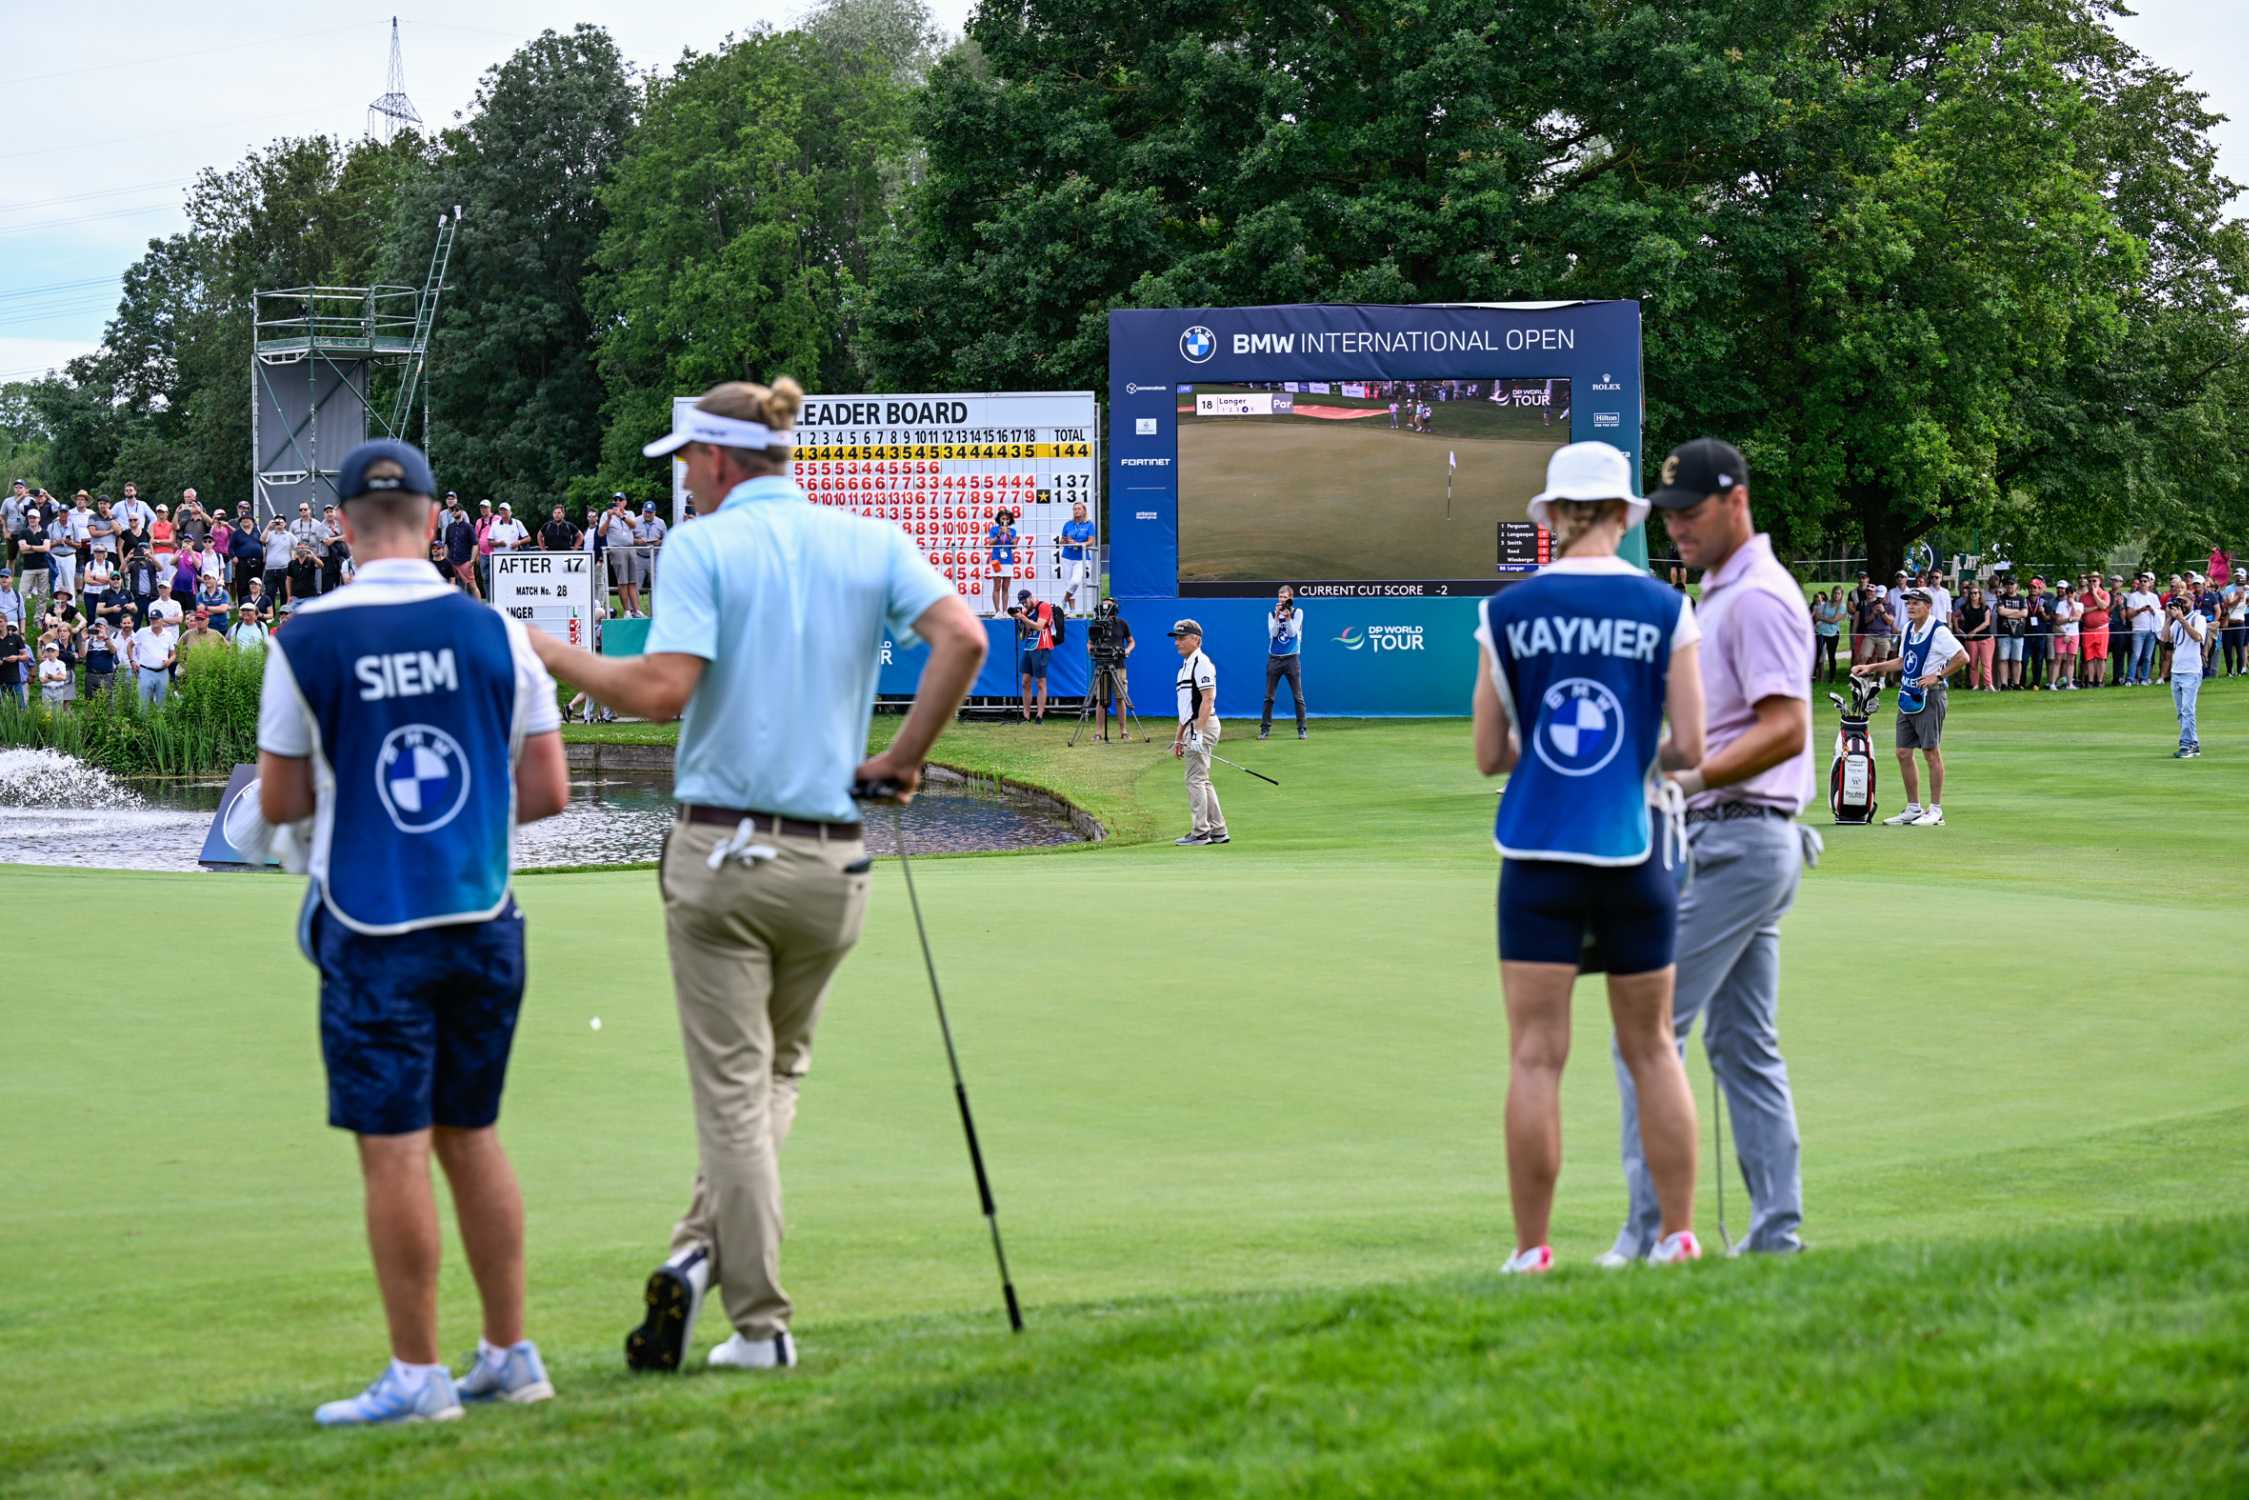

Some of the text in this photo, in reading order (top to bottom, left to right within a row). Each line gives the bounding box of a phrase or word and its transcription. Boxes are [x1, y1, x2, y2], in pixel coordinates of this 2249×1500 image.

[1233, 328, 1574, 354] BMW INTERNATIONAL OPEN
[1592, 383, 1620, 391] ROLEX
[1201, 401, 1213, 409] 18
[1219, 398, 1246, 406] Langer
[1273, 400, 1293, 409] Par
[1513, 395, 1550, 407] TOUR
[795, 402, 968, 426] EADER BOARD
[1595, 414, 1618, 422] Hilton
[810, 432, 816, 445] 2
[824, 432, 830, 444] 3
[836, 431, 844, 444] 4
[850, 431, 856, 444] 5
[864, 431, 870, 444] 6
[876, 431, 884, 444] 7
[890, 431, 898, 444] 8
[904, 431, 910, 444] 9
[914, 431, 926, 443] 10
[928, 430, 938, 443] 11
[942, 430, 954, 443] 12
[956, 430, 968, 443] 13
[970, 430, 982, 443] 14
[984, 430, 994, 443] 15
[996, 430, 1008, 442] 16
[1010, 429, 1022, 442] 17
[1024, 429, 1036, 442] 18
[1055, 429, 1085, 441] TOTAL
[794, 448, 804, 460] 4
[808, 448, 818, 460] 3
[820, 448, 832, 460] 4
[834, 448, 844, 460] 4
[848, 447, 858, 459] 4
[862, 447, 872, 459] 5
[874, 447, 886, 459] 4
[890, 447, 900, 459] 3
[902, 447, 912, 459] 5
[916, 447, 926, 459] 4
[930, 446, 940, 458] 5
[944, 446, 952, 458] 3
[956, 446, 966, 458] 4
[970, 446, 980, 458] 4
[984, 446, 994, 458] 4
[996, 446, 1008, 458] 4
[1012, 446, 1020, 458] 3
[1024, 445, 1034, 457] 5
[795, 461, 939, 476] 5 5 5 5 3 4 4 5 5 5 6
[808, 478, 818, 490] 6
[822, 478, 831, 489] 6
[835, 478, 844, 489] 6
[849, 477, 858, 489] 6
[862, 477, 871, 489] 6
[876, 477, 885, 489] 6
[890, 477, 898, 489] 7
[903, 477, 912, 489] 7
[916, 477, 926, 488] 3
[930, 477, 939, 488] 3
[944, 476, 953, 488] 4
[957, 476, 966, 488] 4
[971, 476, 980, 488] 5
[984, 476, 994, 488] 5
[998, 476, 1007, 488] 4
[1012, 476, 1021, 487] 4
[1025, 476, 1035, 487] 4
[808, 493, 818, 504] 9
[821, 492, 832, 504] 10
[834, 492, 845, 504] 10
[848, 492, 858, 504] 11
[861, 492, 872, 504] 12
[875, 492, 886, 504] 13
[888, 492, 900, 503] 13
[902, 492, 913, 503] 13
[916, 491, 926, 503] 6
[930, 491, 939, 503] 7
[944, 491, 952, 503] 7
[958, 491, 966, 503] 7
[971, 491, 980, 503] 8
[984, 491, 994, 502] 9
[998, 491, 1007, 502] 7
[1012, 490, 1020, 502] 7
[1025, 490, 1035, 502] 9
[876, 506, 1021, 520] 3 3 5 5 5 5 6 7 8 8
[916, 522, 980, 534] 8 9 10 10 9
[930, 551, 1034, 565] 6 6 6 6 7
[499, 558, 584, 573] AFTER 17
[944, 566, 1035, 580] 4 5 4 6
[516, 586, 538, 595] MATCH
[557, 585, 568, 597] 28
[957, 582, 980, 595] 8 8
[1300, 585, 1448, 596] CURRENT CUT SCORE -2
[507, 606, 534, 619] NGER
[1368, 626, 1424, 634] DP WORLD
[1369, 635, 1424, 653] TOUR
[1506, 616, 1661, 663] KAYMER
[355, 648, 459, 701] SIEM
